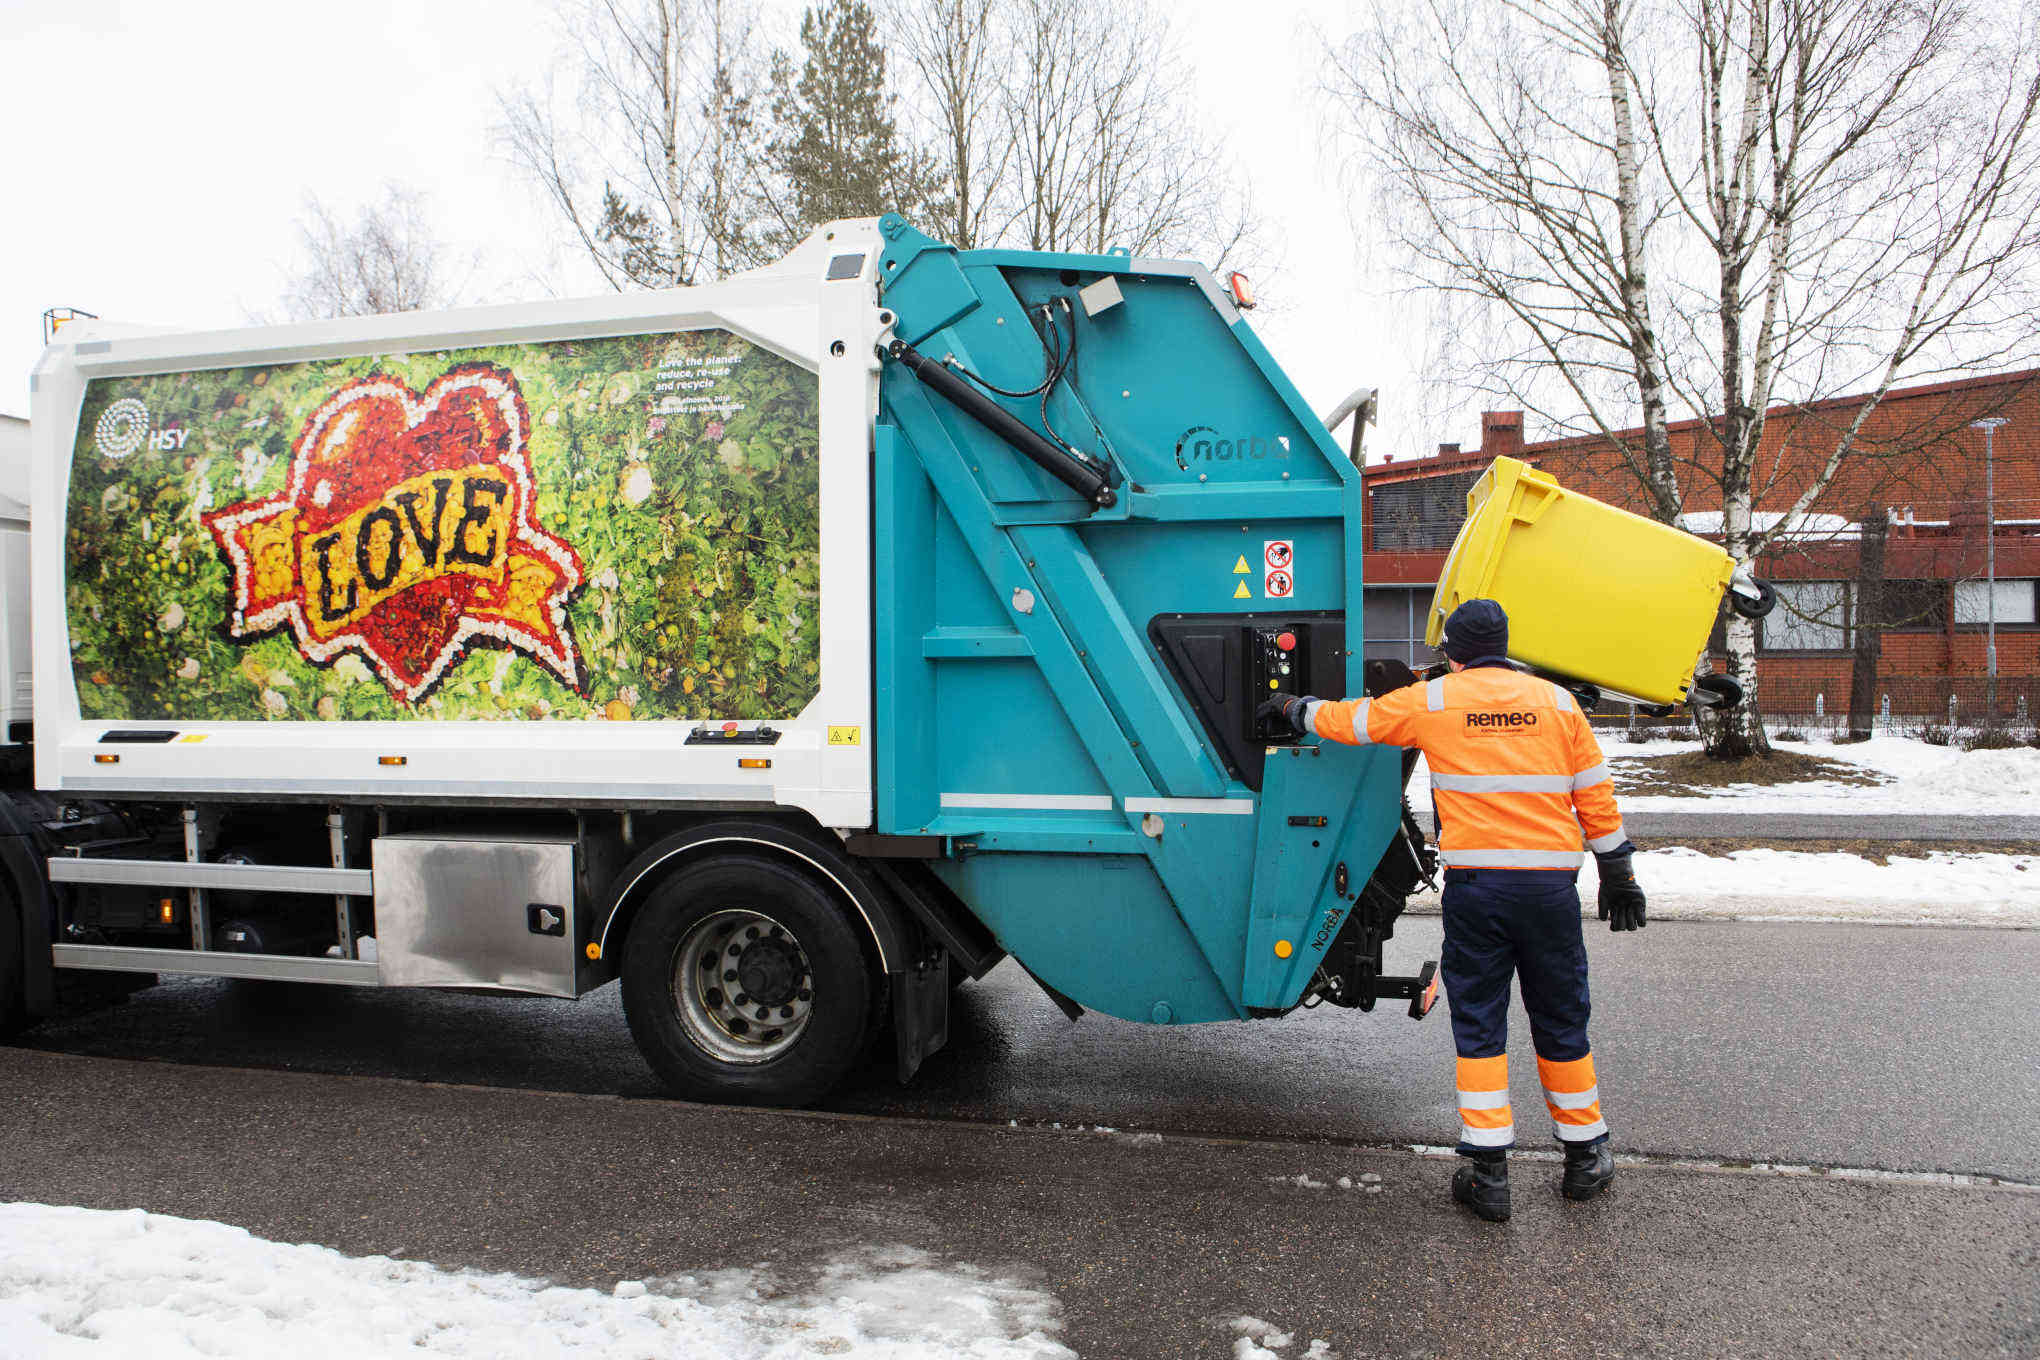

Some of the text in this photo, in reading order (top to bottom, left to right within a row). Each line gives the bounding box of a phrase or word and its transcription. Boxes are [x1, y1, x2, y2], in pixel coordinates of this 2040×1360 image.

[659, 359, 683, 368] Love
[686, 357, 703, 366] the
[656, 368, 731, 379] reduce, re-use
[655, 378, 715, 391] and recycle
[148, 428, 192, 451] HSY
[312, 477, 508, 622] LOVE
[1465, 711, 1538, 728] Remeo
[1311, 907, 1346, 953] NORBA
